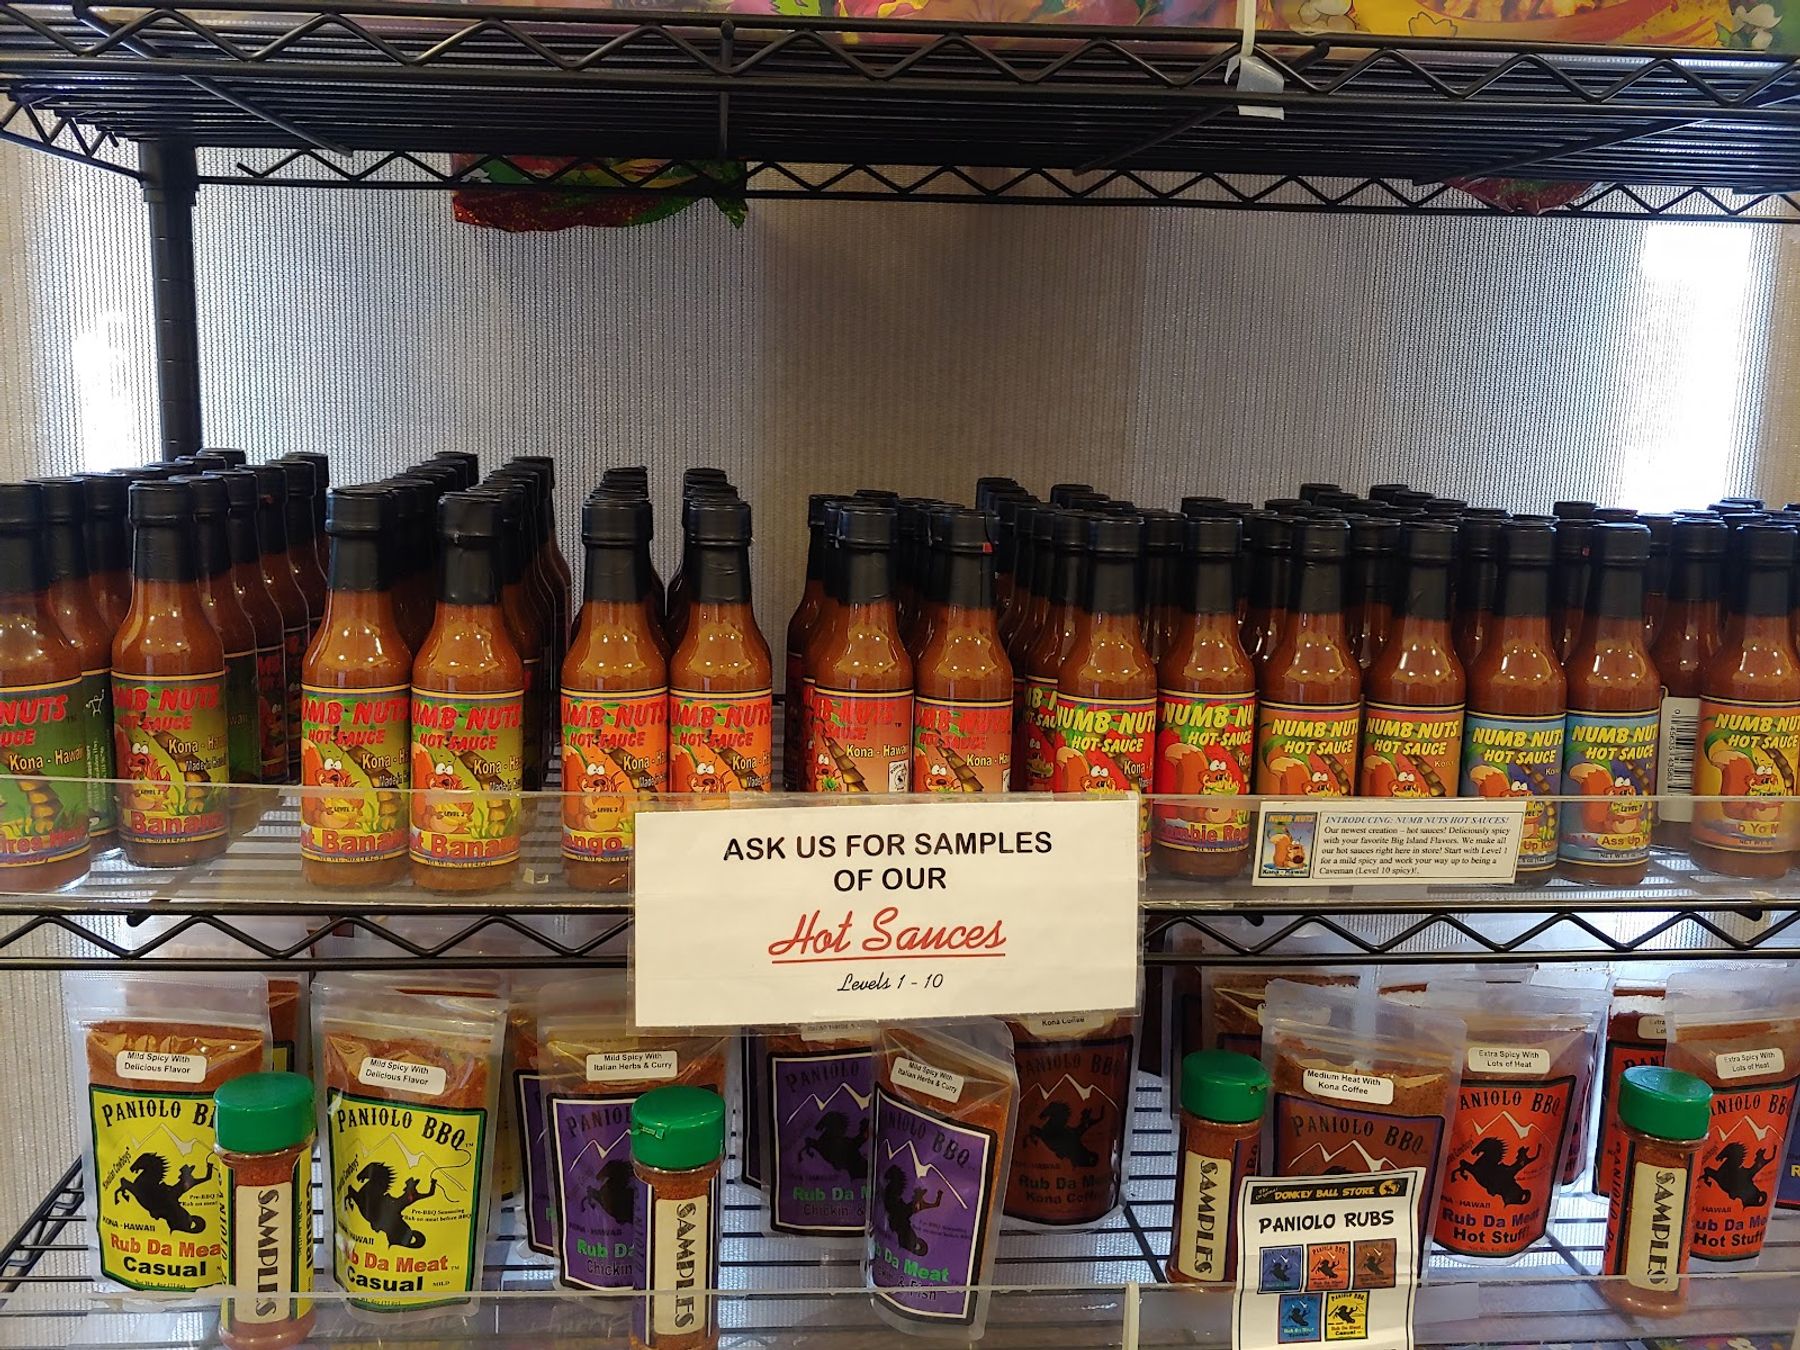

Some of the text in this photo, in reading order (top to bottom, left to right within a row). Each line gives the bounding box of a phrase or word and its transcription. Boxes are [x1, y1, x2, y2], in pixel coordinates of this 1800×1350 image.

[168, 739, 198, 754] Kona
[1284, 740, 1353, 755] HOT SAUCE
[1374, 739, 1447, 756] HOT SAUCE
[1728, 734, 1799, 748] HOT SAUCE
[847, 744, 873, 758] Kona
[1484, 749, 1556, 765] HOT SAUCE
[1585, 747, 1616, 761] HOT
[9, 754, 43, 770] Kona
[362, 752, 391, 769] Kona
[474, 757, 502, 775] Kona
[623, 755, 650, 770] Kona
[732, 755, 759, 770] Kona
[967, 754, 992, 767] Kona
[1471, 816, 1509, 824] SAUCES!
[1324, 826, 1339, 834] Our
[1448, 827, 1489, 835] Deliciously
[1491, 827, 1510, 836] spicy
[723, 830, 1054, 861] ASK US FOR SAMPLES
[1391, 837, 1404, 845] Big
[1601, 836, 1624, 846] Ass
[1375, 847, 1393, 855] right
[1434, 858, 1448, 866] way
[1470, 857, 1491, 865] being
[1319, 867, 1353, 875] Caveman
[1355, 867, 1379, 875] (Level
[833, 867, 946, 892] OF OUR
[768, 906, 1007, 957] Hot Sauces
[837, 973, 891, 993] Levels
[898, 974, 906, 990] 1
[924, 973, 944, 990] 10
[127, 1052, 190, 1064] Mild Spicy With
[604, 1052, 662, 1062] Mild Spicy With
[1499, 1051, 1520, 1060] Spicy
[1741, 1051, 1776, 1063] Spicy With
[124, 1062, 191, 1074] Delicious Flavor
[370, 1058, 429, 1075] Mild Spicy With
[594, 1061, 673, 1071] Italian Herbs Curry
[1747, 1063, 1755, 1071] of
[365, 1069, 428, 1085] Delicious Flavor
[1307, 1070, 1381, 1086] Medium Heat With
[1318, 1082, 1368, 1095] Kona Coffee
[102, 1100, 181, 1127] PANIOLO
[337, 1107, 467, 1151] PANIOLO BBQ
[1291, 1115, 1373, 1137] PANIOLO
[1056, 1177, 1077, 1189] Da
[793, 1186, 854, 1200] Rub Da
[1274, 1186, 1374, 1200] DONKEY BALL STORE
[1193, 1159, 1219, 1275] SAMPLES
[1259, 1210, 1394, 1233] PANIOLO RUBS
[1443, 1208, 1506, 1227] Rub Da
[1724, 1218, 1744, 1231] Da
[124, 1223, 155, 1232] HAWAII
[1453, 1227, 1485, 1243] Hot
[1647, 1170, 1676, 1286] SAMPLES
[111, 1233, 172, 1256] Rub Da
[576, 1238, 608, 1258] Rub
[1694, 1232, 1726, 1248] Hot
[255, 1189, 279, 1318] SAMPLES
[123, 1256, 206, 1277] Casual
[365, 1252, 448, 1272] Da Meat
[674, 1202, 696, 1329] SAMPLES
[347, 1266, 423, 1292] Casual
[903, 1261, 949, 1283] Meat
